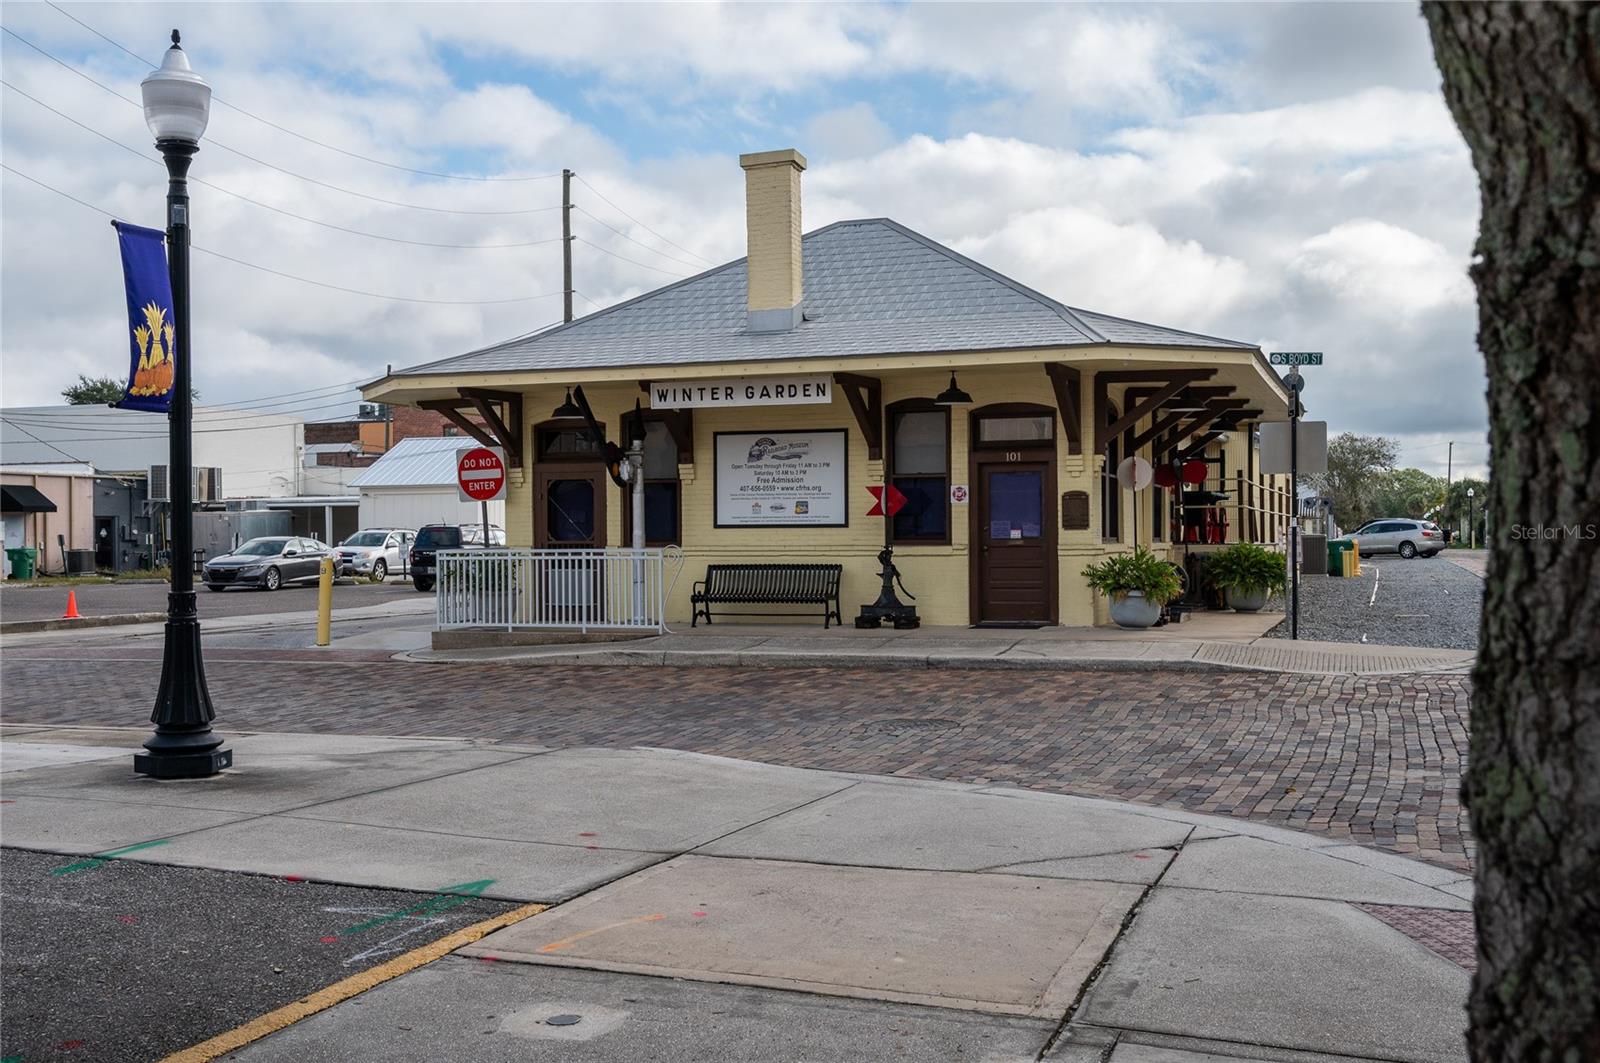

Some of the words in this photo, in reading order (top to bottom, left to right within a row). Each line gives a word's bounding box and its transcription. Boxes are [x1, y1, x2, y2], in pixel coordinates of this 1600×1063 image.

[1281, 353, 1287, 364] S
[1289, 353, 1309, 364] BOYD
[1311, 353, 1321, 364] ST
[656, 386, 734, 402] WINTER
[744, 383, 826, 399] GARDEN
[1005, 451, 1022, 462] 101
[463, 459, 476, 468] DO
[479, 457, 497, 467] NOT
[468, 481, 496, 491] ENTER
